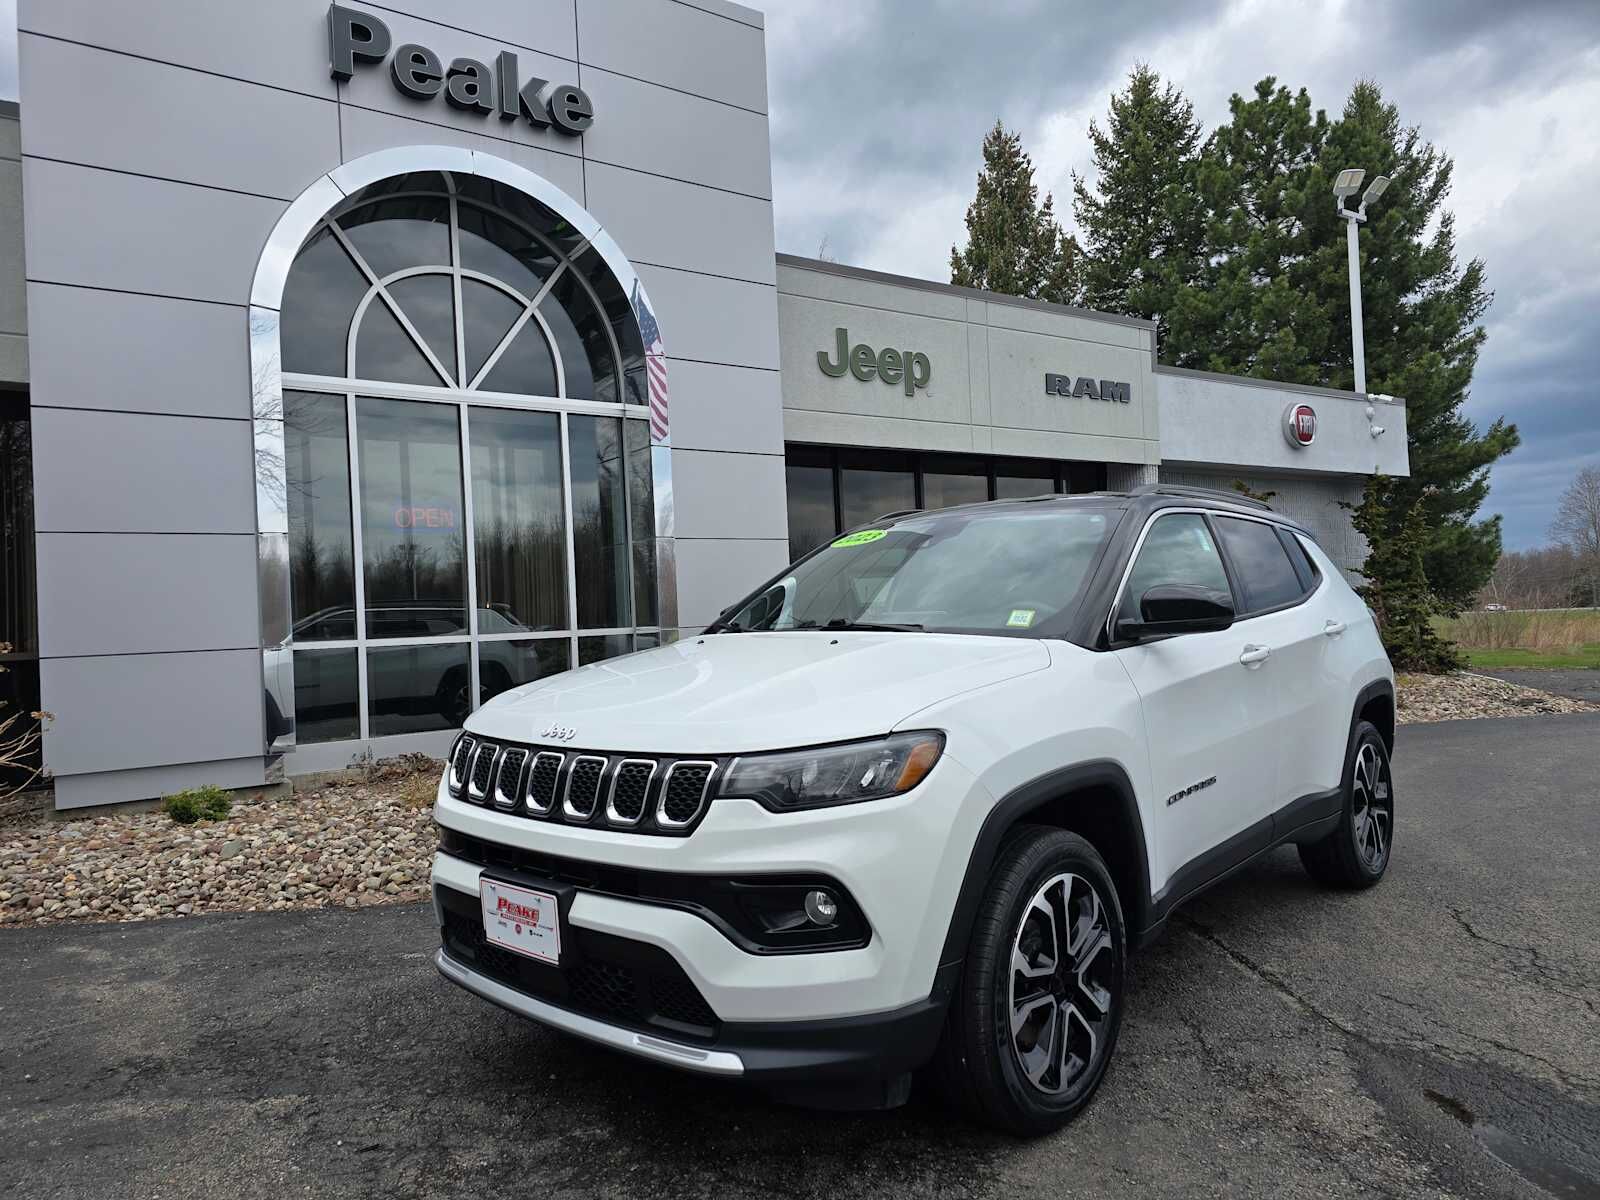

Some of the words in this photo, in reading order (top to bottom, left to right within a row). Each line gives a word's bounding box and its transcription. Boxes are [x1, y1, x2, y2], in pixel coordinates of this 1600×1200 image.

[327, 3, 593, 136] Peake
[817, 327, 931, 397] Jeep
[1045, 372, 1131, 403] RAM
[394, 507, 454, 528] OPEN
[540, 721, 577, 743] Jeep
[1166, 775, 1217, 807] COMPASS
